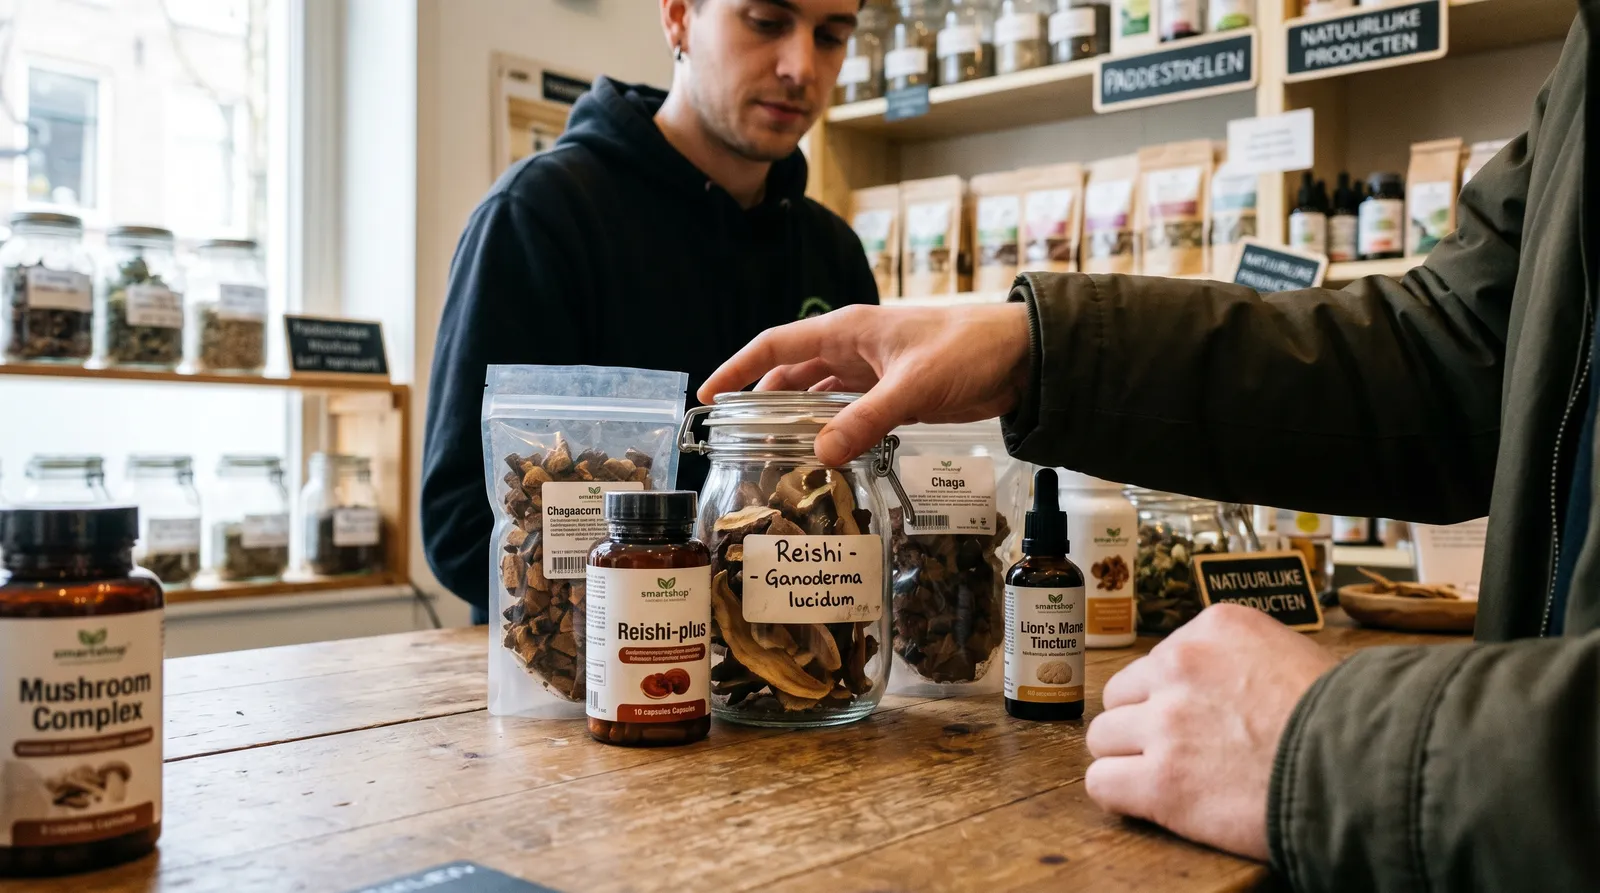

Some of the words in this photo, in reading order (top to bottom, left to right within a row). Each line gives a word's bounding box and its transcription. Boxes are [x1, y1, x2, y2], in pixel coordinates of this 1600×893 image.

[1301, 8, 1421, 46] NATUURLIJKE
[1304, 32, 1418, 68] PRODUCTEN
[1104, 50, 1245, 96] PADDESTOELEN
[931, 477, 965, 489] Chaga
[547, 506, 601, 517] Chagaacorn
[775, 539, 842, 562] Reishi
[765, 568, 863, 588] Ganoderma
[1209, 569, 1303, 591] NATUURLIJKE
[641, 587, 689, 599] smartshop
[789, 590, 854, 608] lucidum
[1035, 602, 1073, 610] smartshop
[618, 621, 706, 643] Reishi-plus
[1021, 621, 1055, 635] Lion's
[1059, 622, 1084, 634] Mane
[1031, 636, 1077, 649] Tincture
[20, 673, 151, 703] Mushroom
[33, 701, 143, 732] Complex
[644, 707, 671, 716] capsules
[672, 705, 696, 714] Capsules
